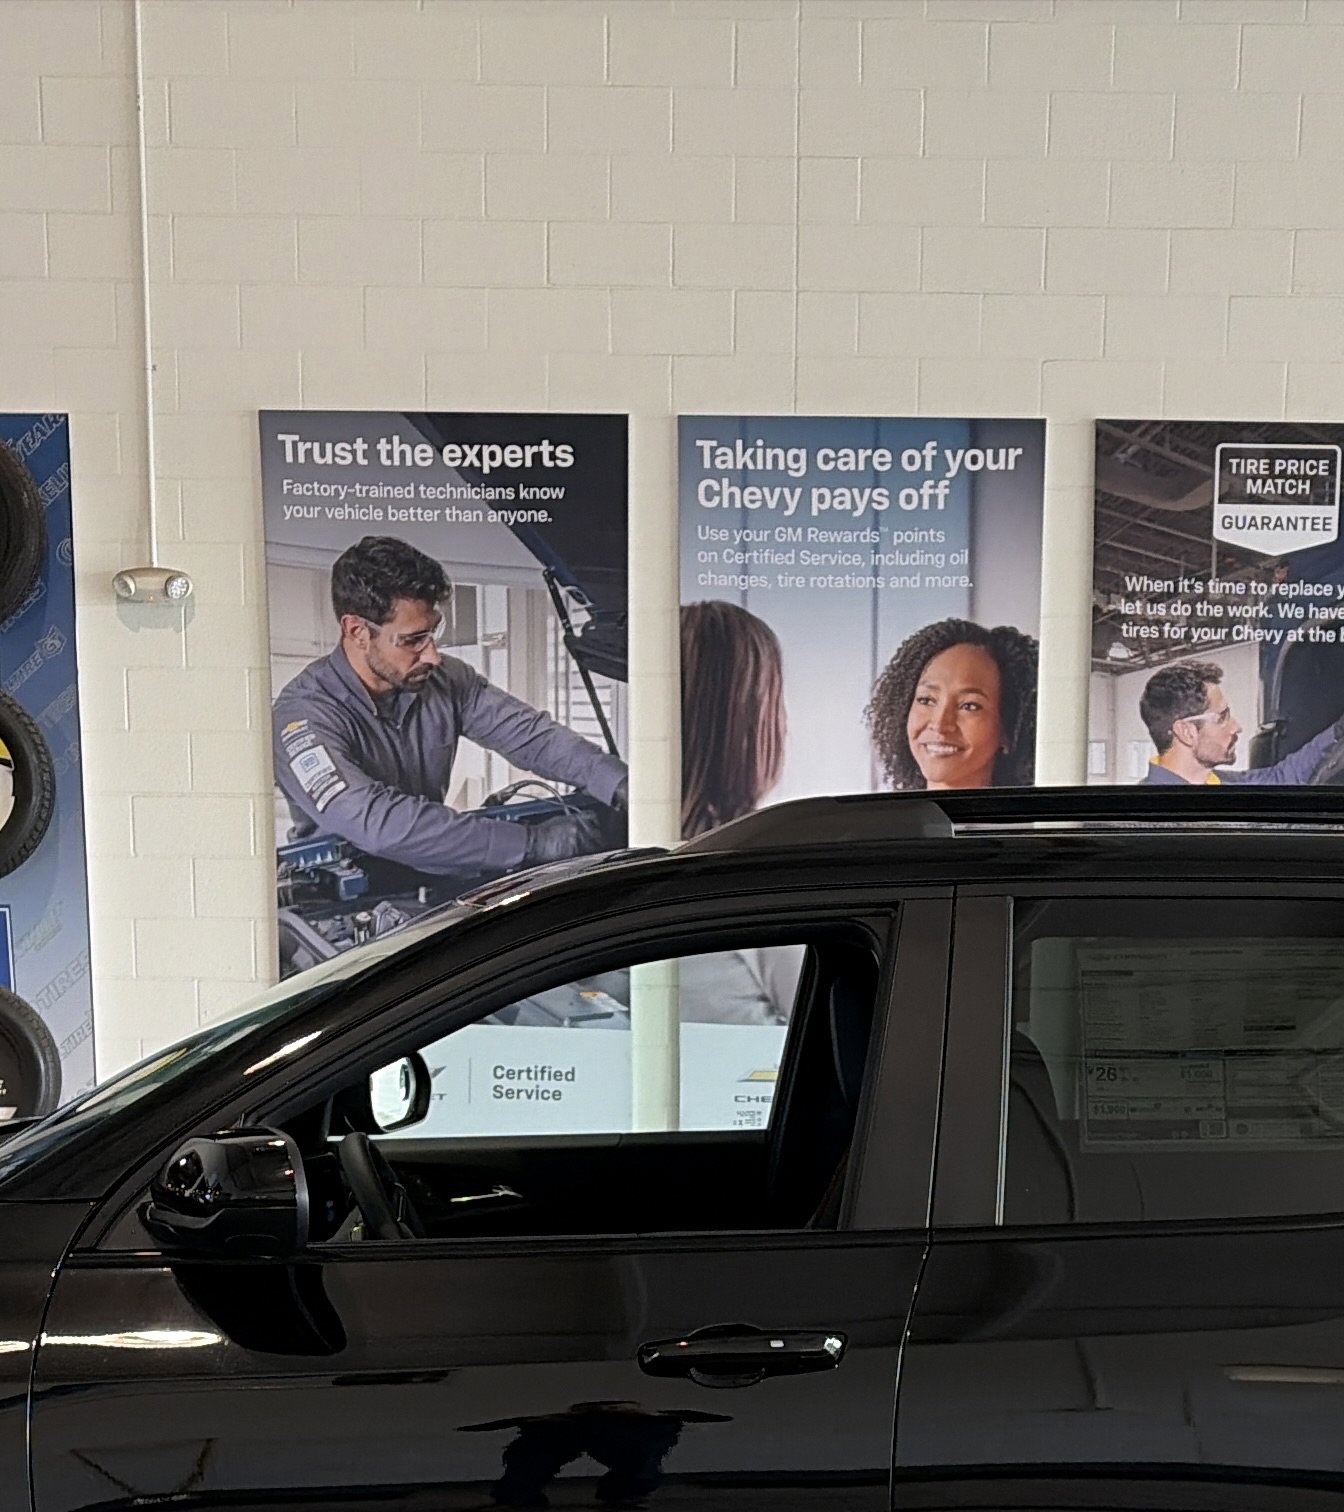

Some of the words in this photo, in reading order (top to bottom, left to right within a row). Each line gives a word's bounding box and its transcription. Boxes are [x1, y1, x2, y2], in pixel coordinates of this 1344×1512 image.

[277, 434, 368, 467] Trust
[376, 435, 434, 468] the
[442, 438, 575, 474] experts
[696, 439, 807, 477] Taking
[817, 447, 892, 472] care
[901, 441, 937, 472] of
[945, 447, 1022, 478] your
[1229, 458, 1270, 475] TIRE
[1274, 459, 1329, 476] PRICE
[282, 479, 415, 501] Factory-trained
[419, 482, 515, 500] technicians
[519, 483, 565, 501] know
[1246, 478, 1311, 495] MATCH
[697, 478, 802, 516] Chevy
[811, 486, 889, 517] pays
[899, 480, 950, 511] off
[283, 504, 322, 520] your
[325, 503, 383, 521] vehicle
[387, 505, 439, 522] better
[445, 506, 483, 523] than
[487, 508, 553, 526] anyone.
[1221, 515, 1333, 532] GUARANTEE
[698, 525, 729, 541] Use
[733, 528, 770, 544] your
[775, 527, 803, 542] GM
[893, 528, 945, 545] points
[698, 551, 719, 564] on
[723, 549, 795, 566] Certified
[800, 550, 866, 568] Service,
[871, 549, 945, 569] including
[949, 549, 969, 565] oil
[698, 571, 772, 590] changes,
[778, 573, 805, 588] tire
[810, 573, 885, 588] rotations
[889, 573, 920, 588] and
[925, 575, 973, 588] more.
[1125, 576, 1175, 593] When
[1178, 577, 1204, 594] it's
[1208, 578, 1245, 595] time
[1250, 580, 1267, 595] to
[1272, 579, 1332, 598] replace
[1120, 599, 1144, 616] let
[1148, 602, 1166, 616] us
[1171, 600, 1192, 616] do
[1196, 601, 1224, 617] the
[1228, 603, 1273, 619] work.
[1277, 602, 1304, 619] We
[1122, 623, 1159, 639] tires
[1163, 624, 1188, 640] for
[1191, 628, 1228, 643] your
[1232, 625, 1283, 645] Chevy
[1287, 627, 1305, 642] at
[1309, 627, 1336, 643] the
[492, 1064, 576, 1083] Certified
[492, 1084, 563, 1102] Service
